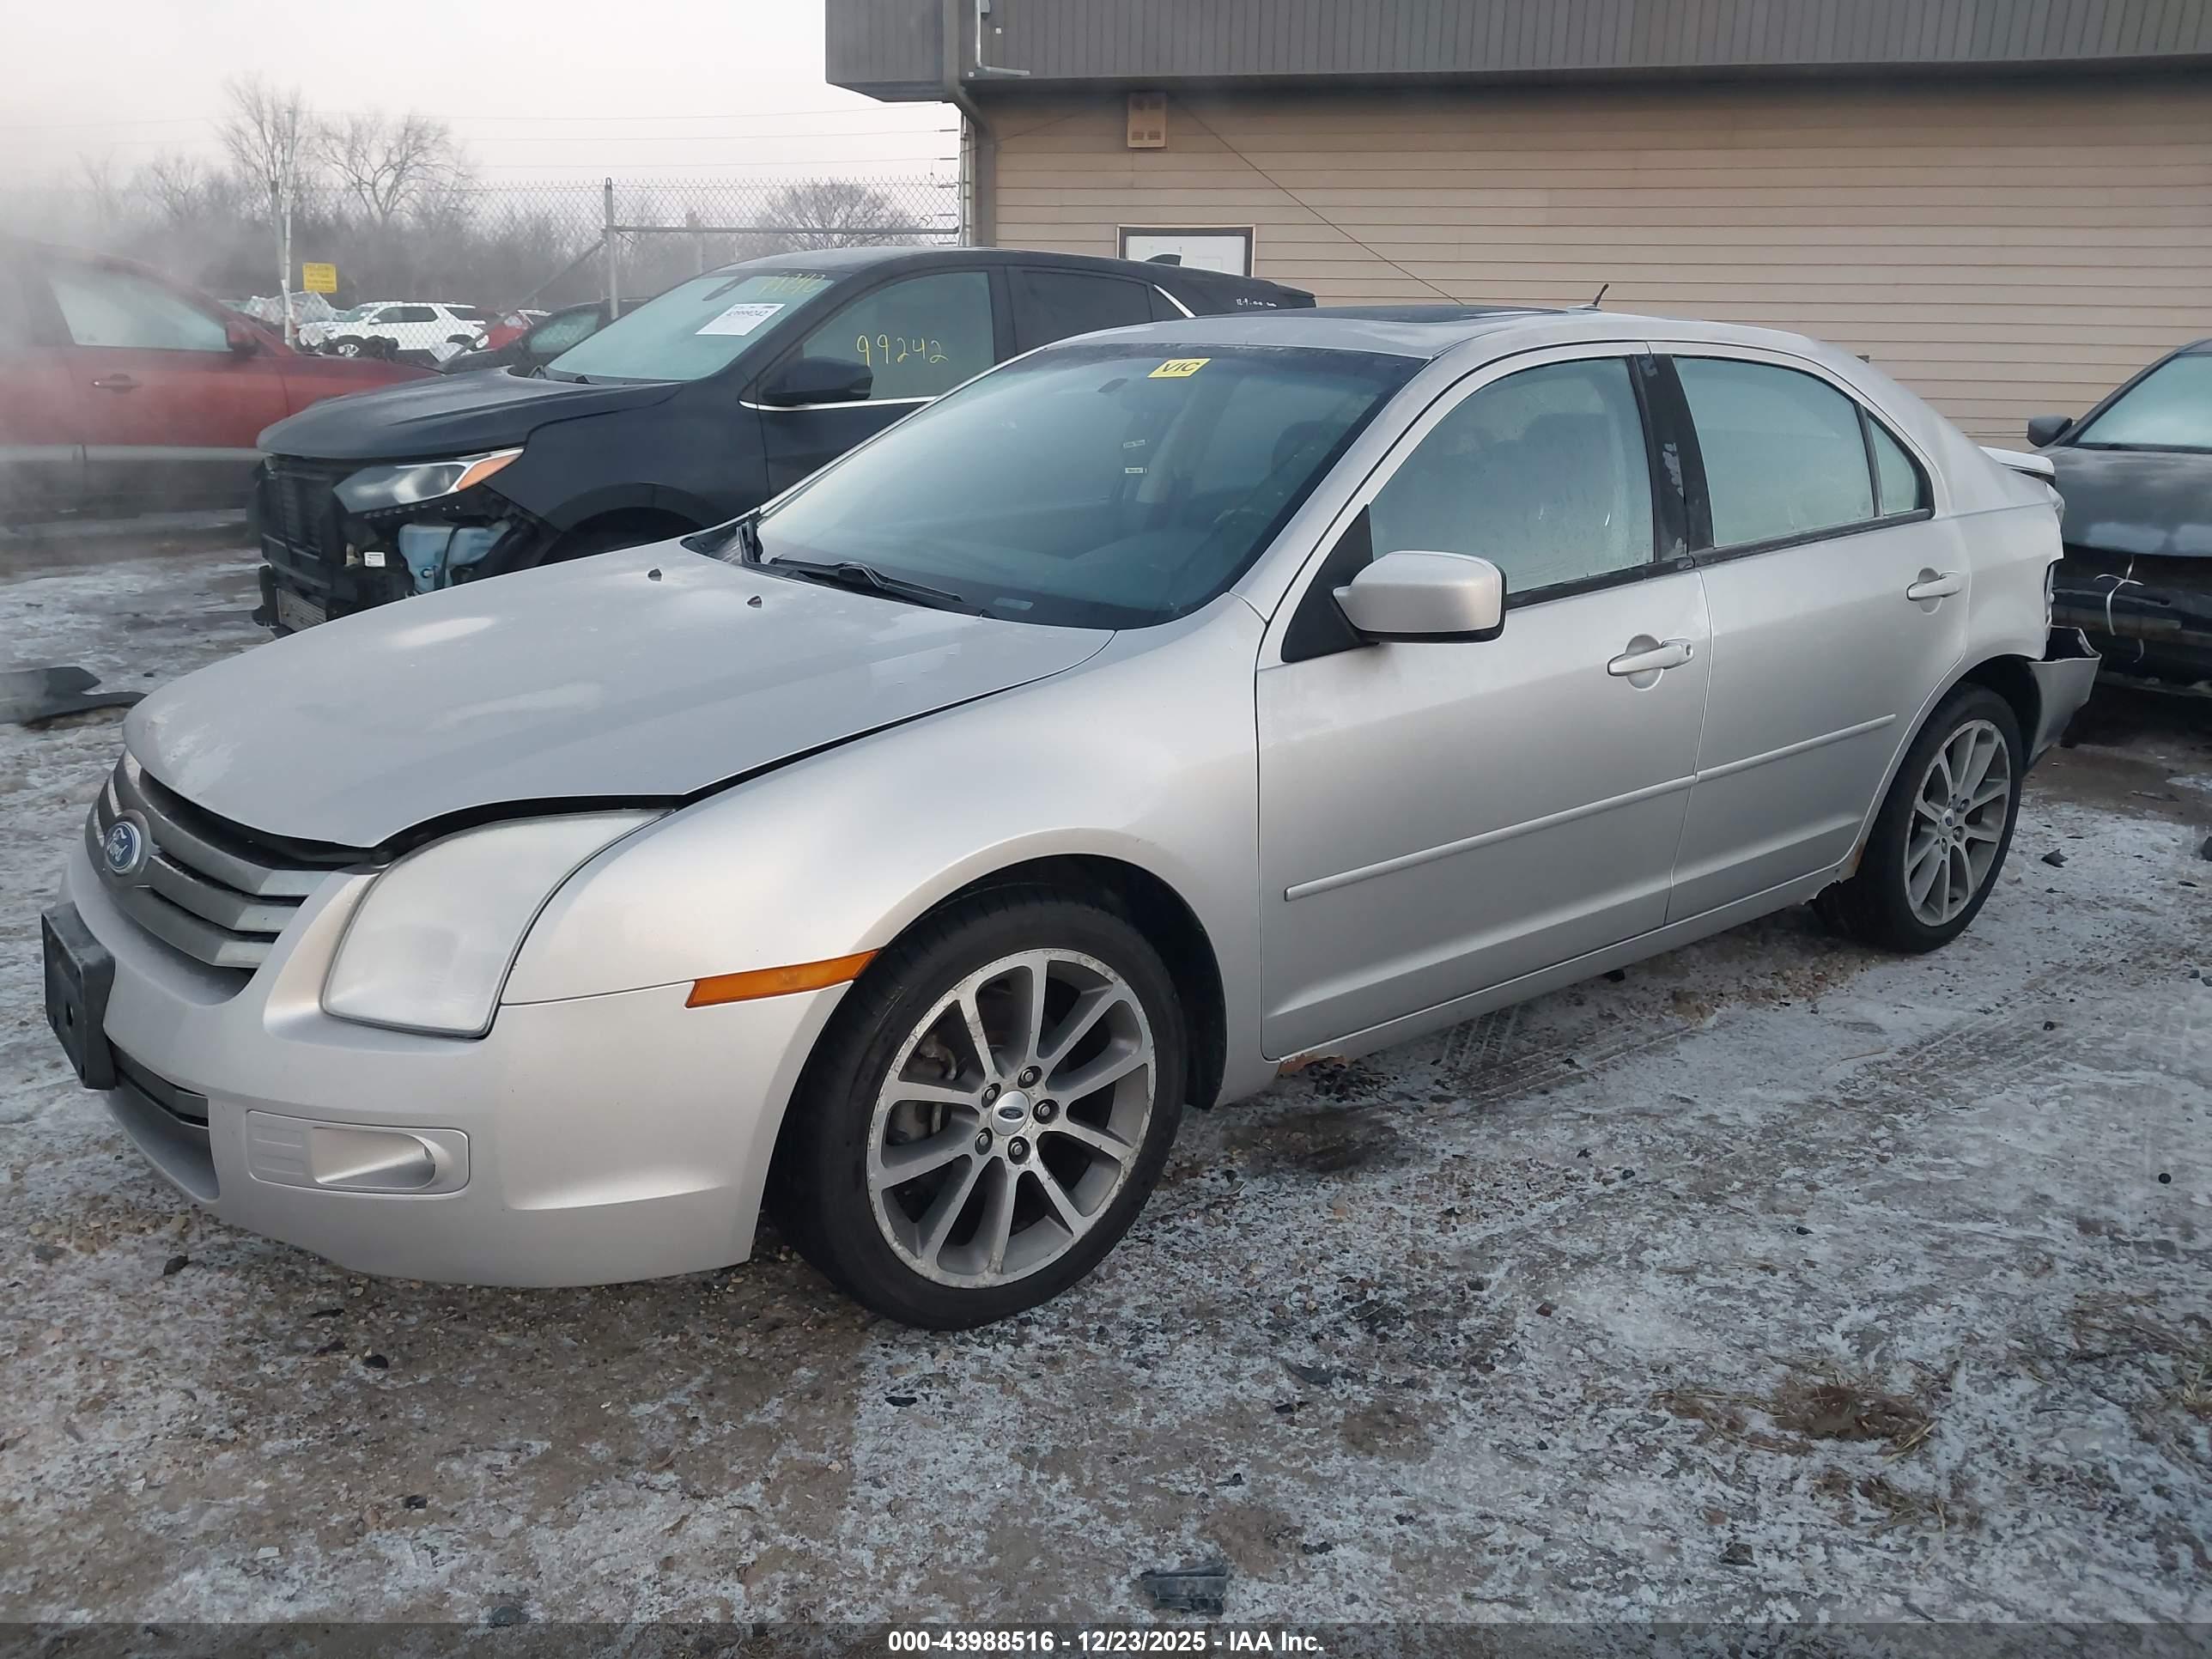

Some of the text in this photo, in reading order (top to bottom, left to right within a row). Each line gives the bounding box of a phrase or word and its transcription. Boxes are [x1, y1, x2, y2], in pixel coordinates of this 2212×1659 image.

[857, 334, 948, 368] 99242
[1162, 362, 1200, 372] VIC
[107, 828, 129, 862] Ford
